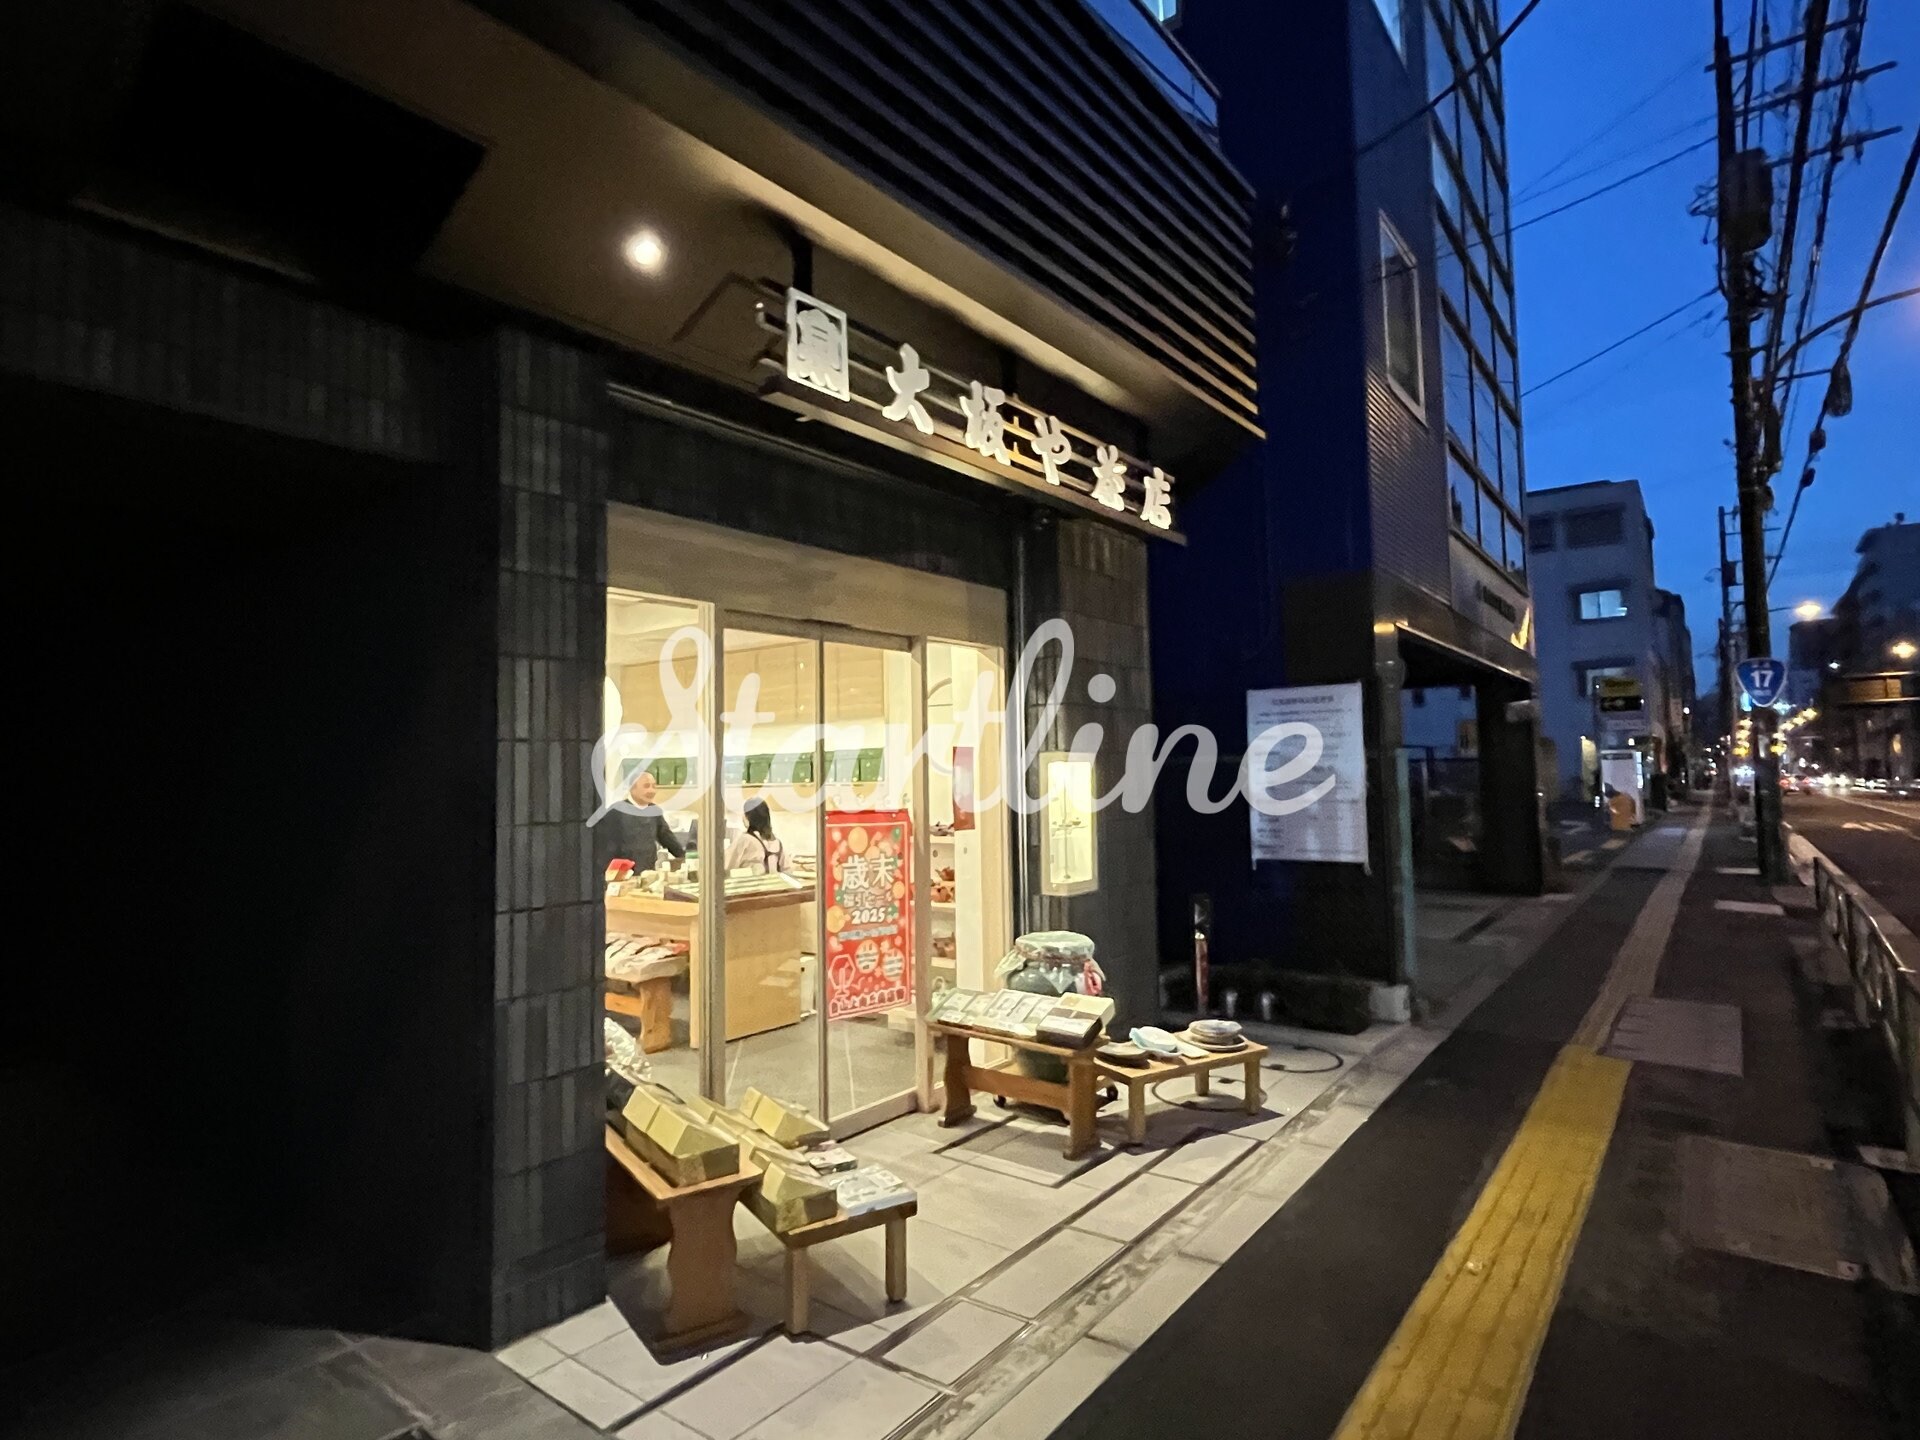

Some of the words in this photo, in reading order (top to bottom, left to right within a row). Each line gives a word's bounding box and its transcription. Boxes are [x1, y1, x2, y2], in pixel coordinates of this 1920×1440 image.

[1750, 670, 1775, 688] 17
[841, 853, 895, 891] 歳末
[851, 907, 886, 924] 2025
